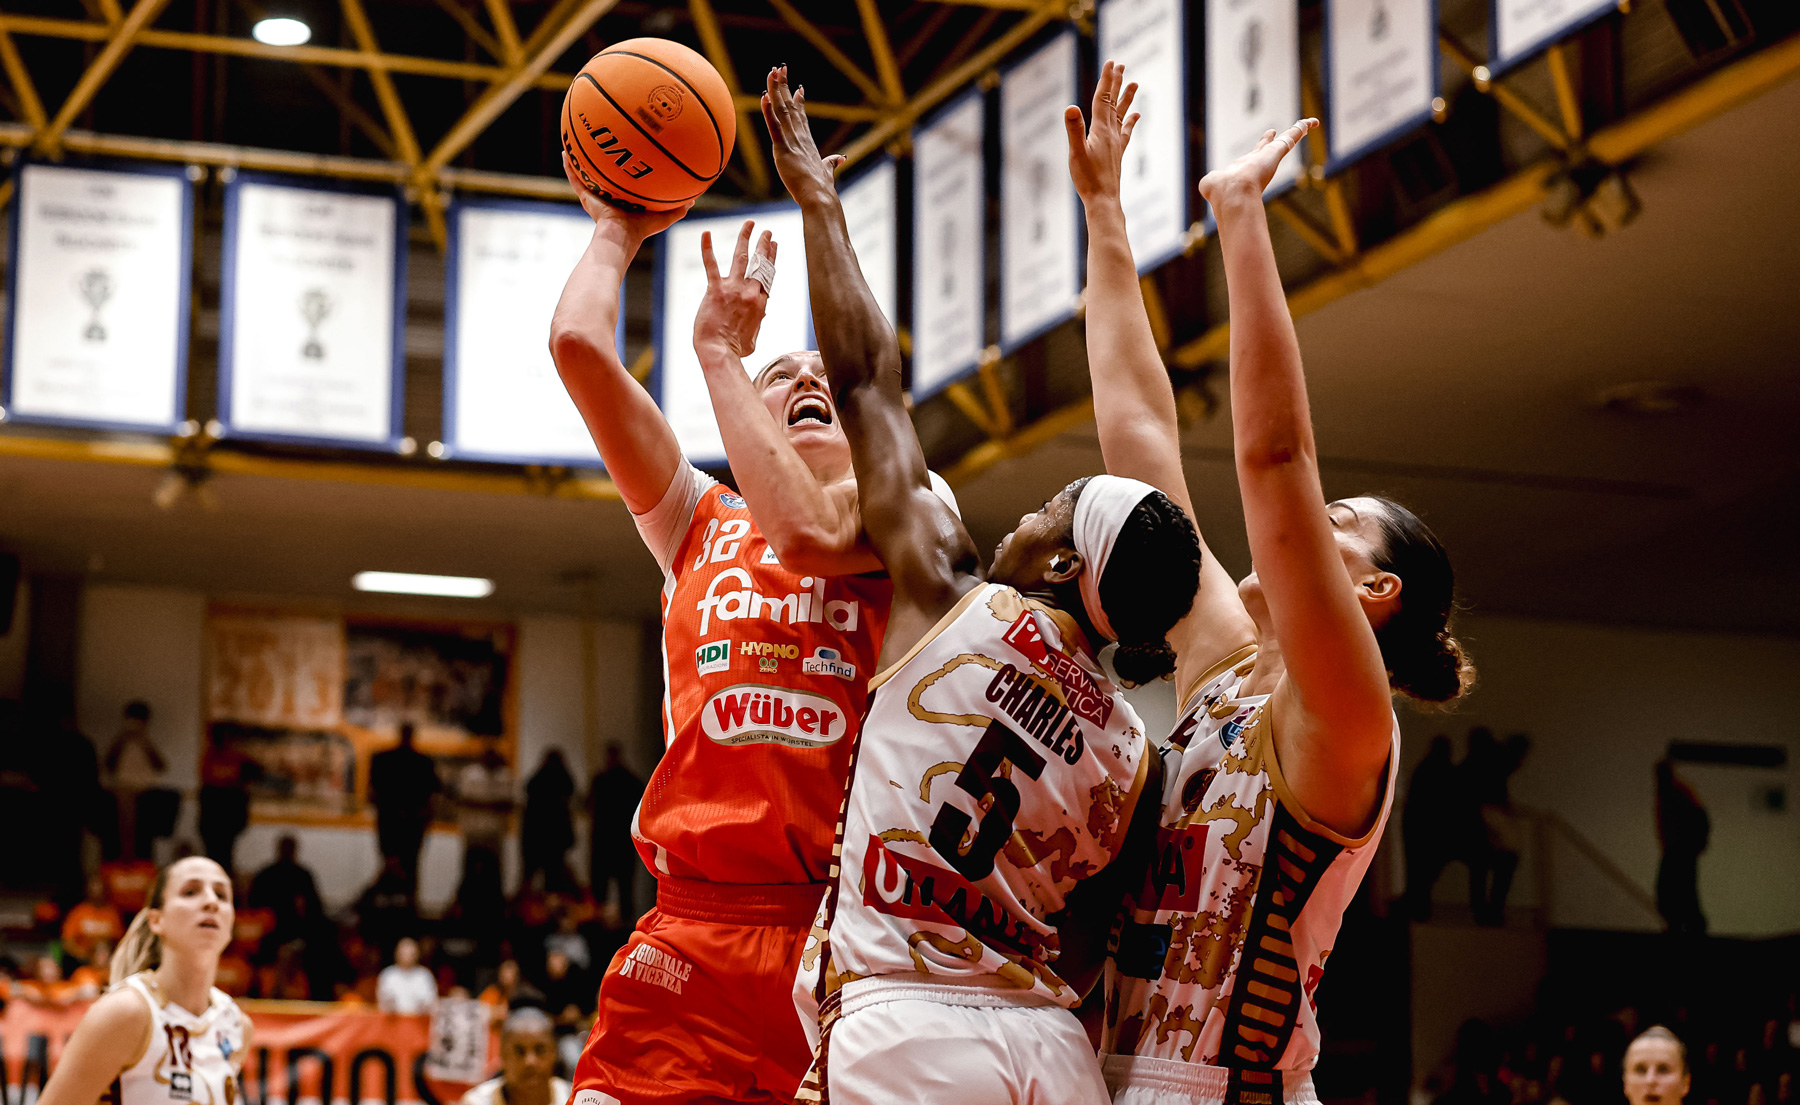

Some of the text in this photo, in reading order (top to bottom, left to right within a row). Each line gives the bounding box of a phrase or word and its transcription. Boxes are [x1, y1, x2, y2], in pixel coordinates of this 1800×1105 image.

[577, 112, 654, 179] EVO NXT
[692, 518, 751, 571] 32
[696, 567, 859, 636] famila
[697, 643, 728, 668] HDI
[740, 641, 799, 660] HYPNO
[805, 661, 852, 678] Techfind
[713, 692, 838, 736] Wüber
[985, 663, 1084, 765] CHARLES
[1065, 685, 1104, 725] TICA
[731, 734, 769, 744] SPECIALISTA
[929, 718, 1047, 881] 5
[619, 958, 682, 996] DI VICENZA
[636, 943, 693, 982] GIORNALE
